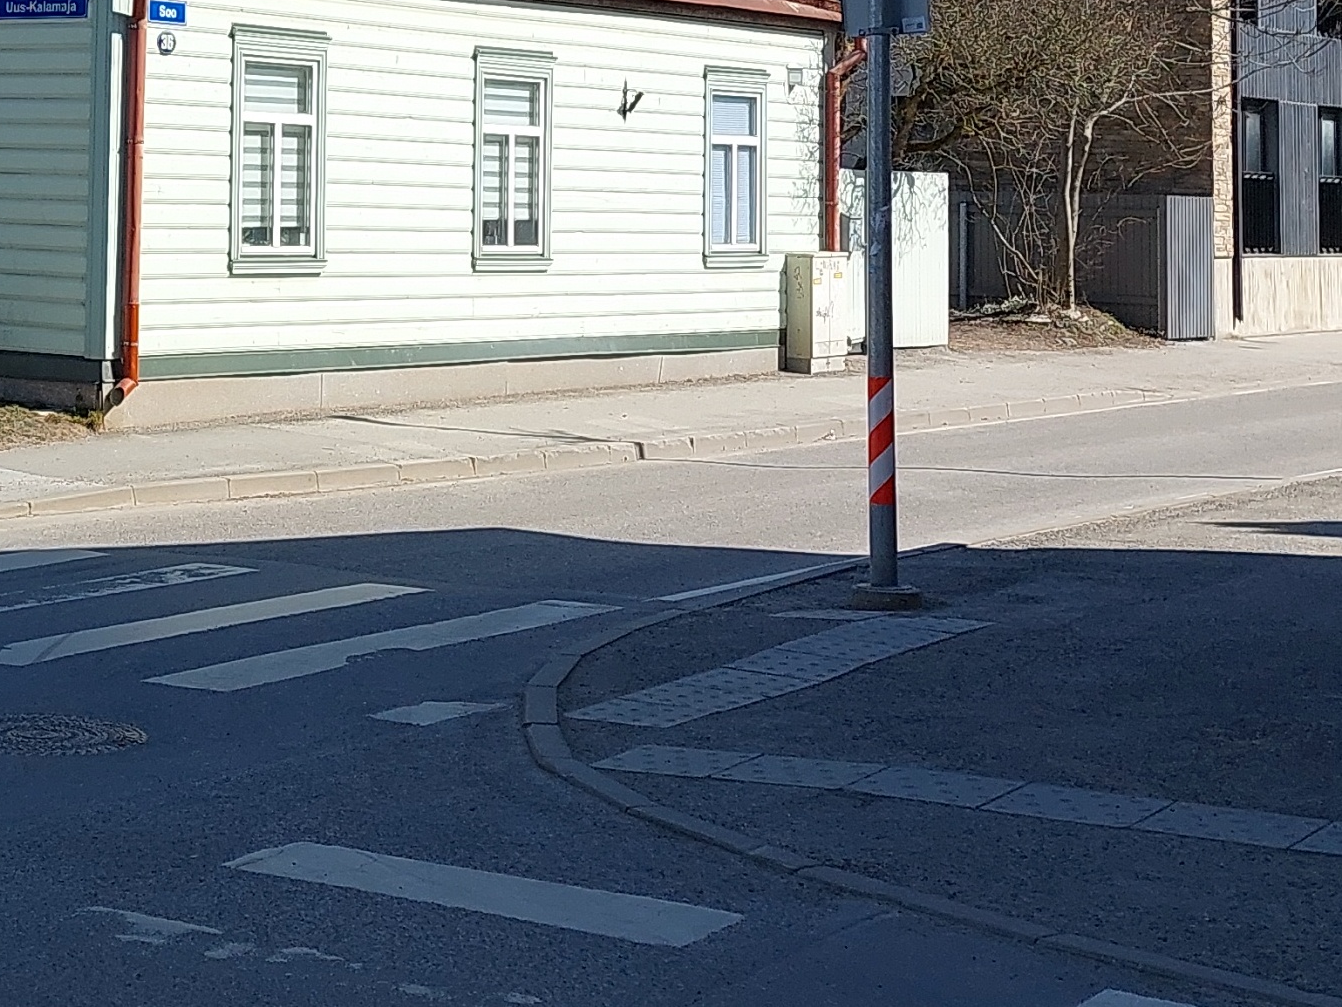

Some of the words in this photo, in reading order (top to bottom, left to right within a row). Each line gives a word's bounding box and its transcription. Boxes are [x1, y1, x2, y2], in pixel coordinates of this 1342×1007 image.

[5, 0, 77, 15] Uus-Kalamaja
[159, 4, 177, 19] Soo
[160, 34, 174, 50] 36
